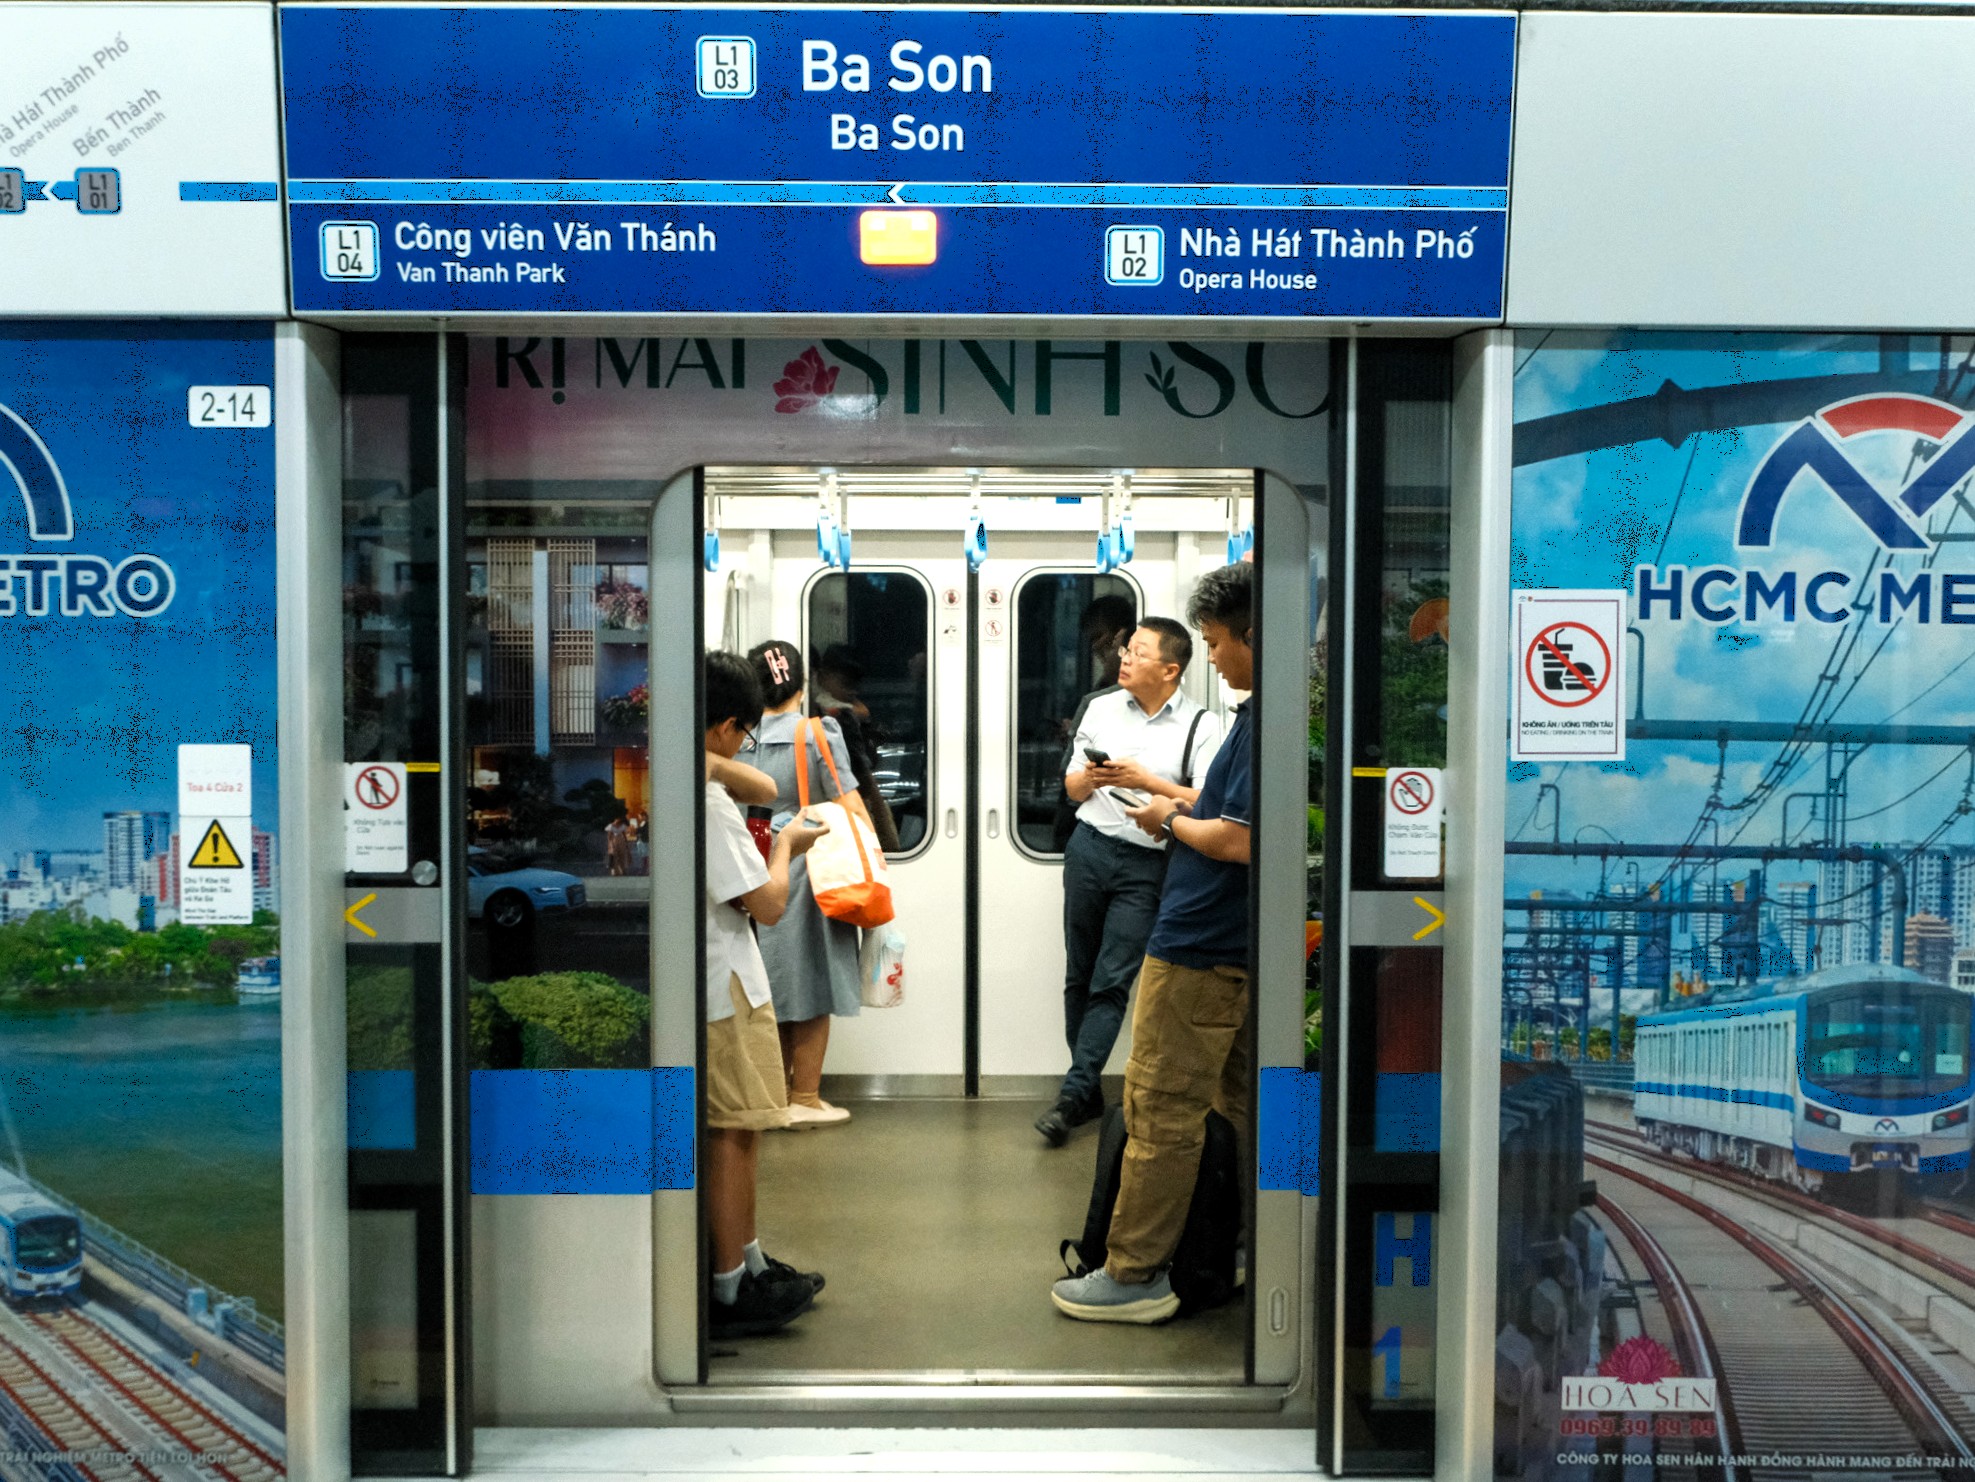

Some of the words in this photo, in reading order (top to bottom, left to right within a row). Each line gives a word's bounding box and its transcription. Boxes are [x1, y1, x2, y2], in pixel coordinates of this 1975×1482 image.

[715, 45, 738, 66] L1
[802, 40, 870, 92] Ba
[888, 40, 992, 93] Son
[39, 64, 96, 107] Thành
[92, 31, 130, 69] Phố
[714, 69, 739, 90] 03
[9, 130, 45, 158] Opera
[42, 104, 79, 133] House
[72, 125, 110, 157] Bến
[105, 88, 162, 130] Thành
[106, 137, 132, 157] Ben
[128, 111, 167, 140] Thanh
[831, 114, 879, 150] Ba
[890, 114, 964, 151] Son
[88, 173, 108, 191] L1
[89, 192, 108, 209] 01
[338, 230, 361, 250] L1
[395, 221, 472, 257] Công
[480, 222, 545, 251] viên
[553, 222, 612, 251] Văn
[620, 222, 717, 252] Thánh
[1123, 233, 1146, 255] L1
[1180, 227, 1241, 257] Nhà
[1251, 228, 1303, 258] Hát
[1311, 228, 1405, 259] Thành
[1415, 226, 1479, 259] Phố
[337, 253, 363, 273] 04
[397, 262, 435, 283] Van
[442, 262, 509, 283] Thanh
[516, 262, 566, 283] Park
[1121, 257, 1147, 278] 02
[1179, 268, 1243, 293] Opera
[1250, 268, 1318, 290] House
[201, 392, 256, 422] 2-14
[1637, 567, 1853, 624] HCMC
[1878, 571, 1975, 626] ME
[237, 782, 244, 792] 2
[1375, 1213, 1432, 1287] H
[1565, 1385, 1637, 1409] HOA
[1655, 1385, 1713, 1409] SEN
[1556, 1451, 1600, 1466] CÔNG
[1603, 1453, 1618, 1466] TY
[1622, 1454, 1652, 1467] HOA
[1656, 1454, 1681, 1467] SEN
[1850, 1456, 1892, 1468] MANG
